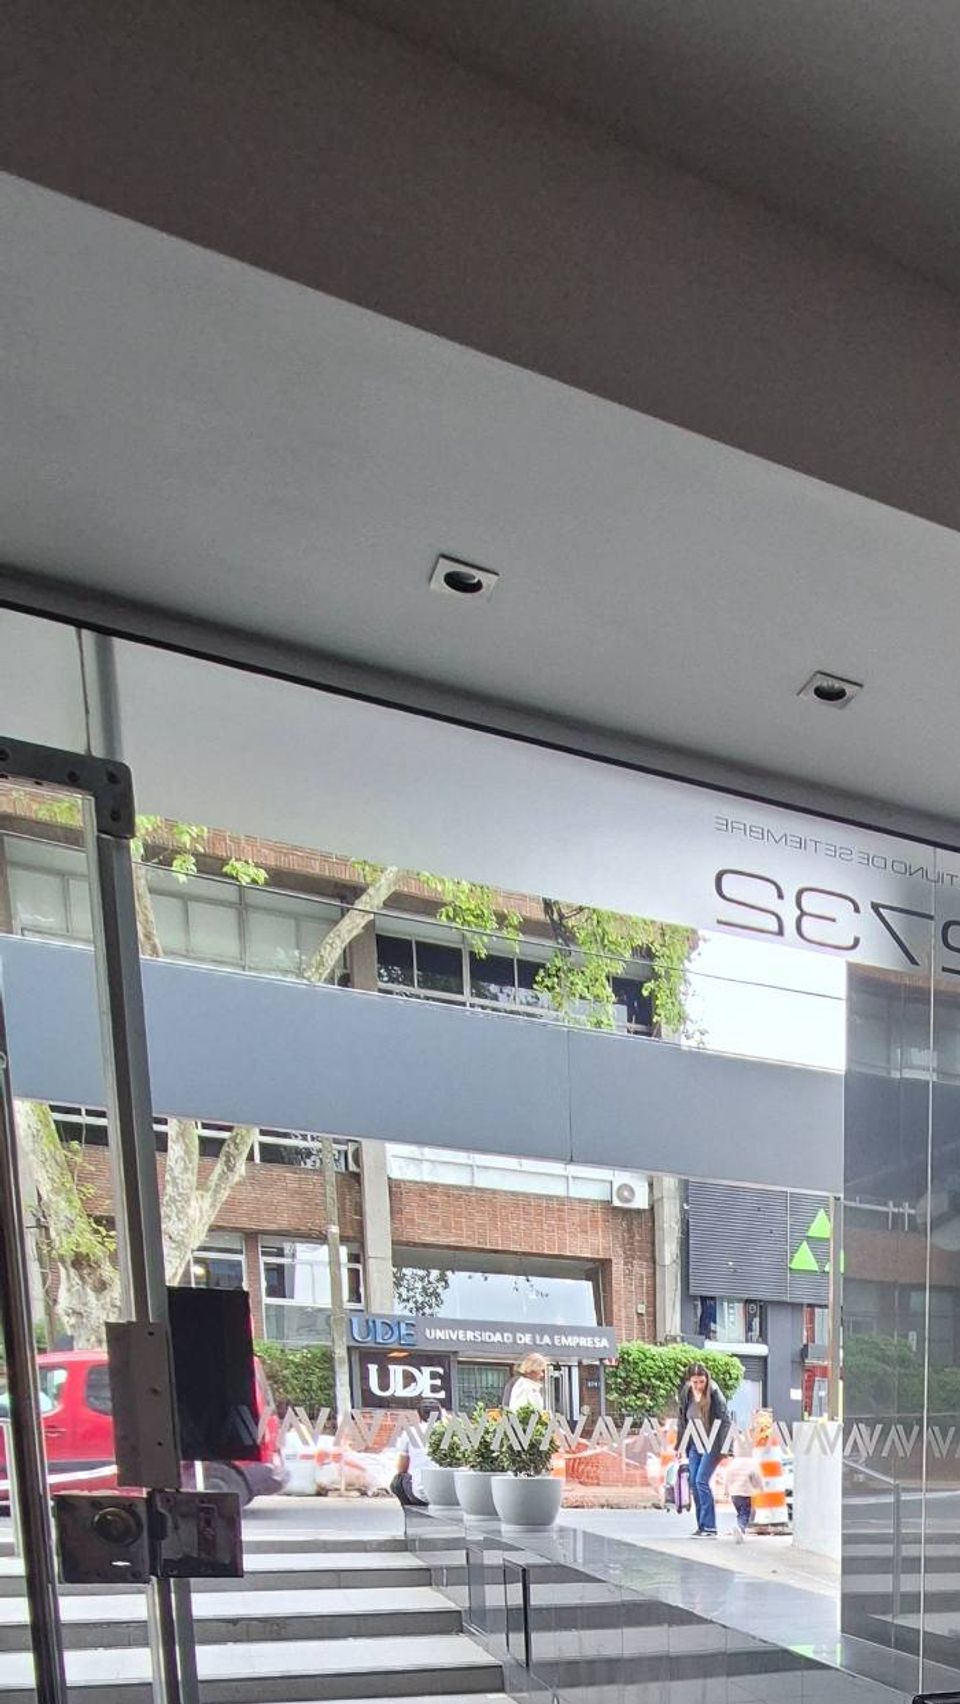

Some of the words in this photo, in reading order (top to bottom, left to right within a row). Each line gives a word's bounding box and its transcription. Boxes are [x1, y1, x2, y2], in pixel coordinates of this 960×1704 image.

[350, 1317, 416, 1346] UDE
[425, 1327, 513, 1343] UNIVERSIDAD
[515, 1332, 533, 1345] DE
[535, 1333, 551, 1346] LA
[554, 1335, 610, 1348] EMPRESA
[367, 1363, 446, 1399] UDE
